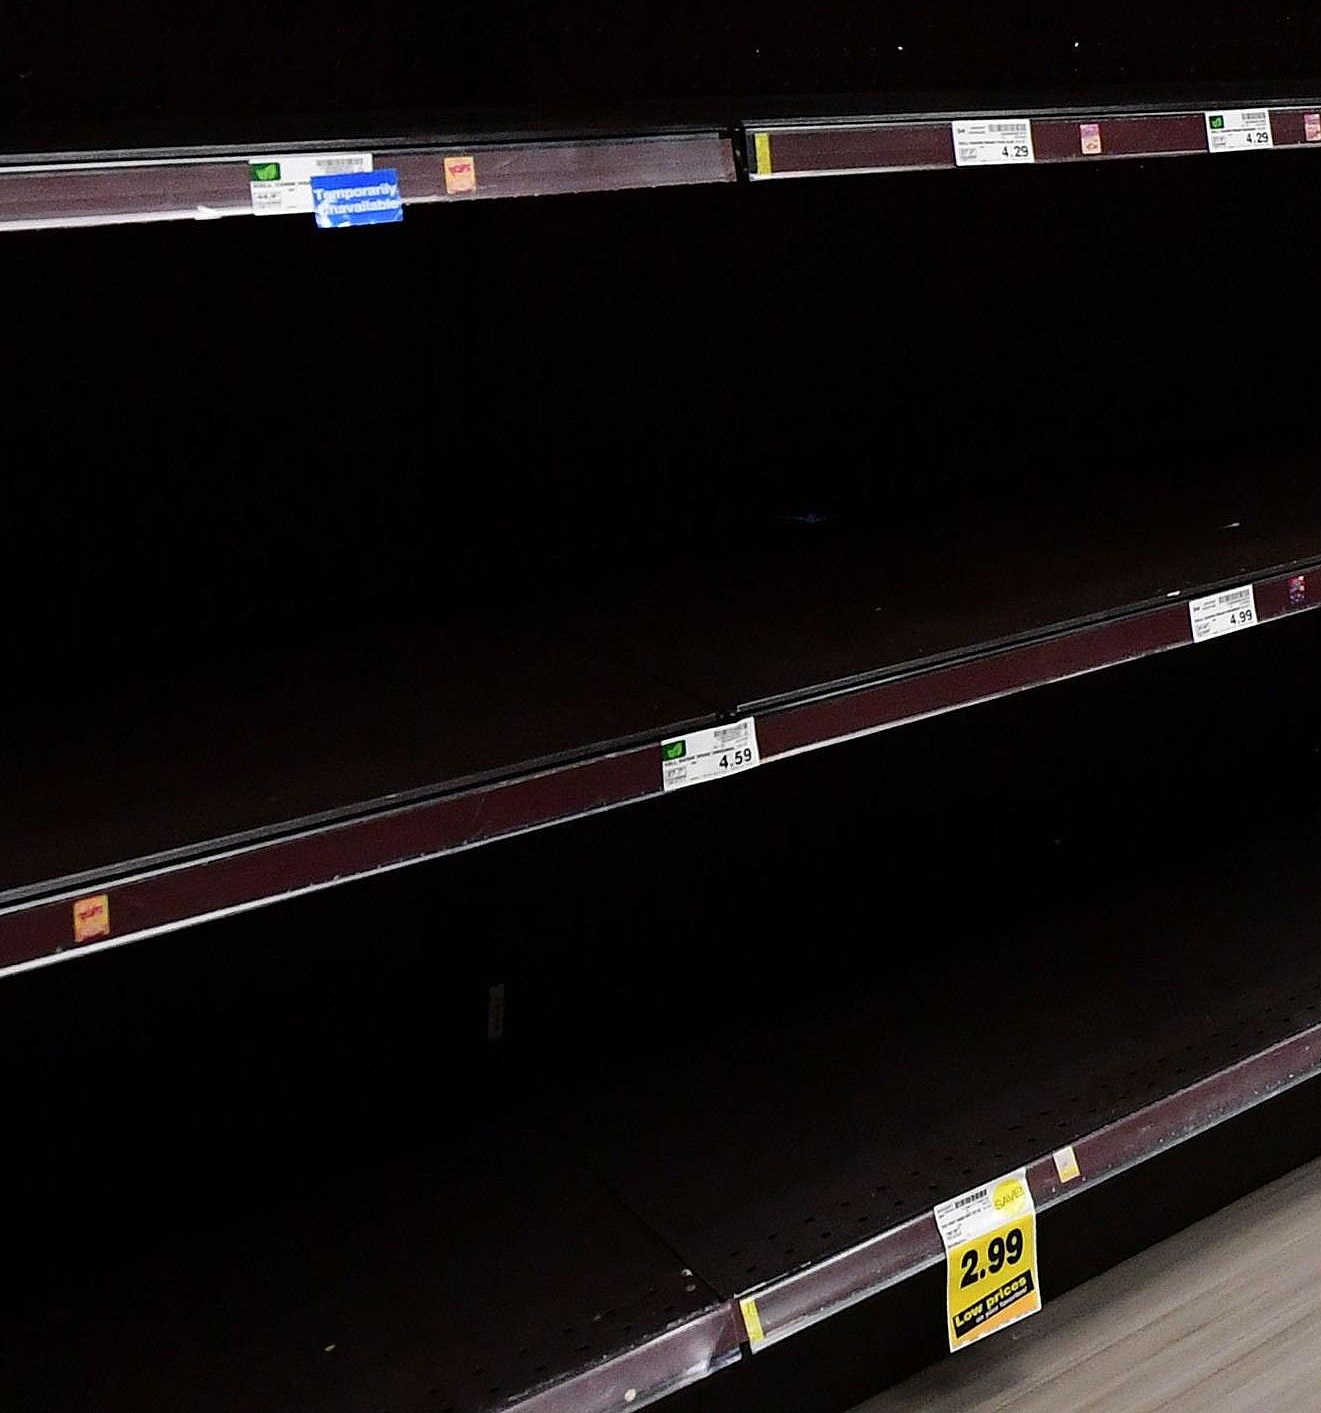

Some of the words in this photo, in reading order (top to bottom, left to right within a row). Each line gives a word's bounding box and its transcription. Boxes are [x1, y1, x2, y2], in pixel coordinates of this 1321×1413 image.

[1246, 132, 1269, 144] 4.29
[1001, 145, 1029, 158] 4.29
[313, 183, 398, 200] Temporarily
[1230, 610, 1253, 626] 4.99
[719, 748, 752, 768] 4.59
[960, 1228, 1023, 1289] 2.99
[955, 1303, 983, 1327] Low
[986, 1277, 1026, 1309] prices
